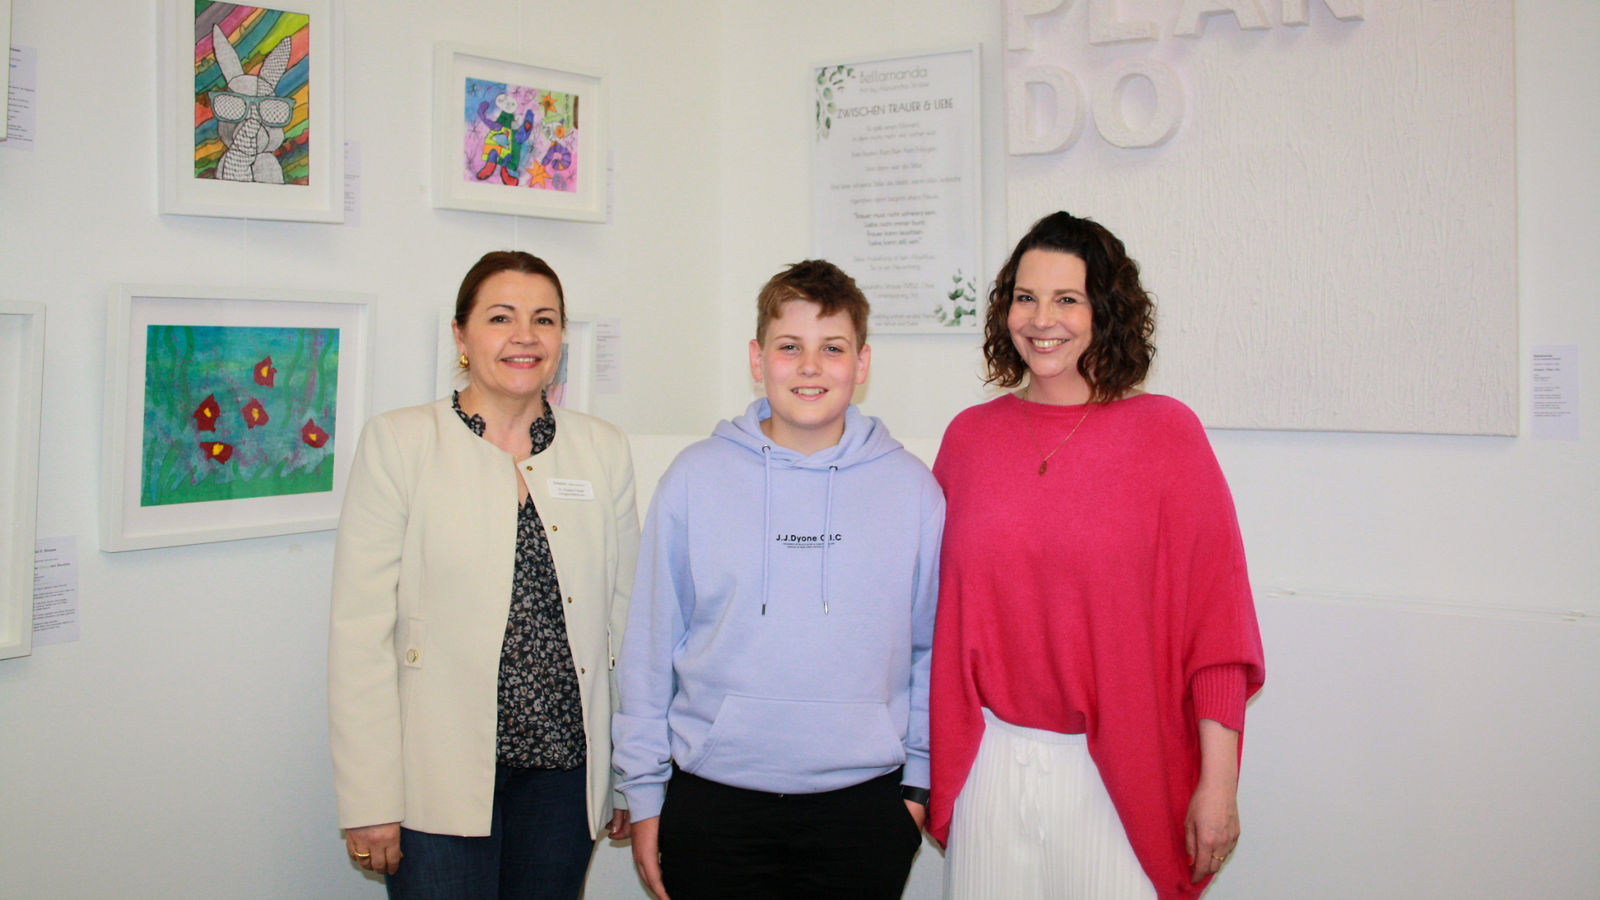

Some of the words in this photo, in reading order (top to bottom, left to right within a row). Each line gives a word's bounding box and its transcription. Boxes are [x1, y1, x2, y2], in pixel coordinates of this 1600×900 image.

[1007, 0, 1365, 53] PL
[836, 105, 886, 119] ZWISCHEN
[888, 101, 921, 113] TRAUER
[923, 101, 931, 111] &
[934, 98, 953, 109] LIEBE
[1007, 61, 1187, 157] DO
[776, 534, 817, 543] J.J.Dyone
